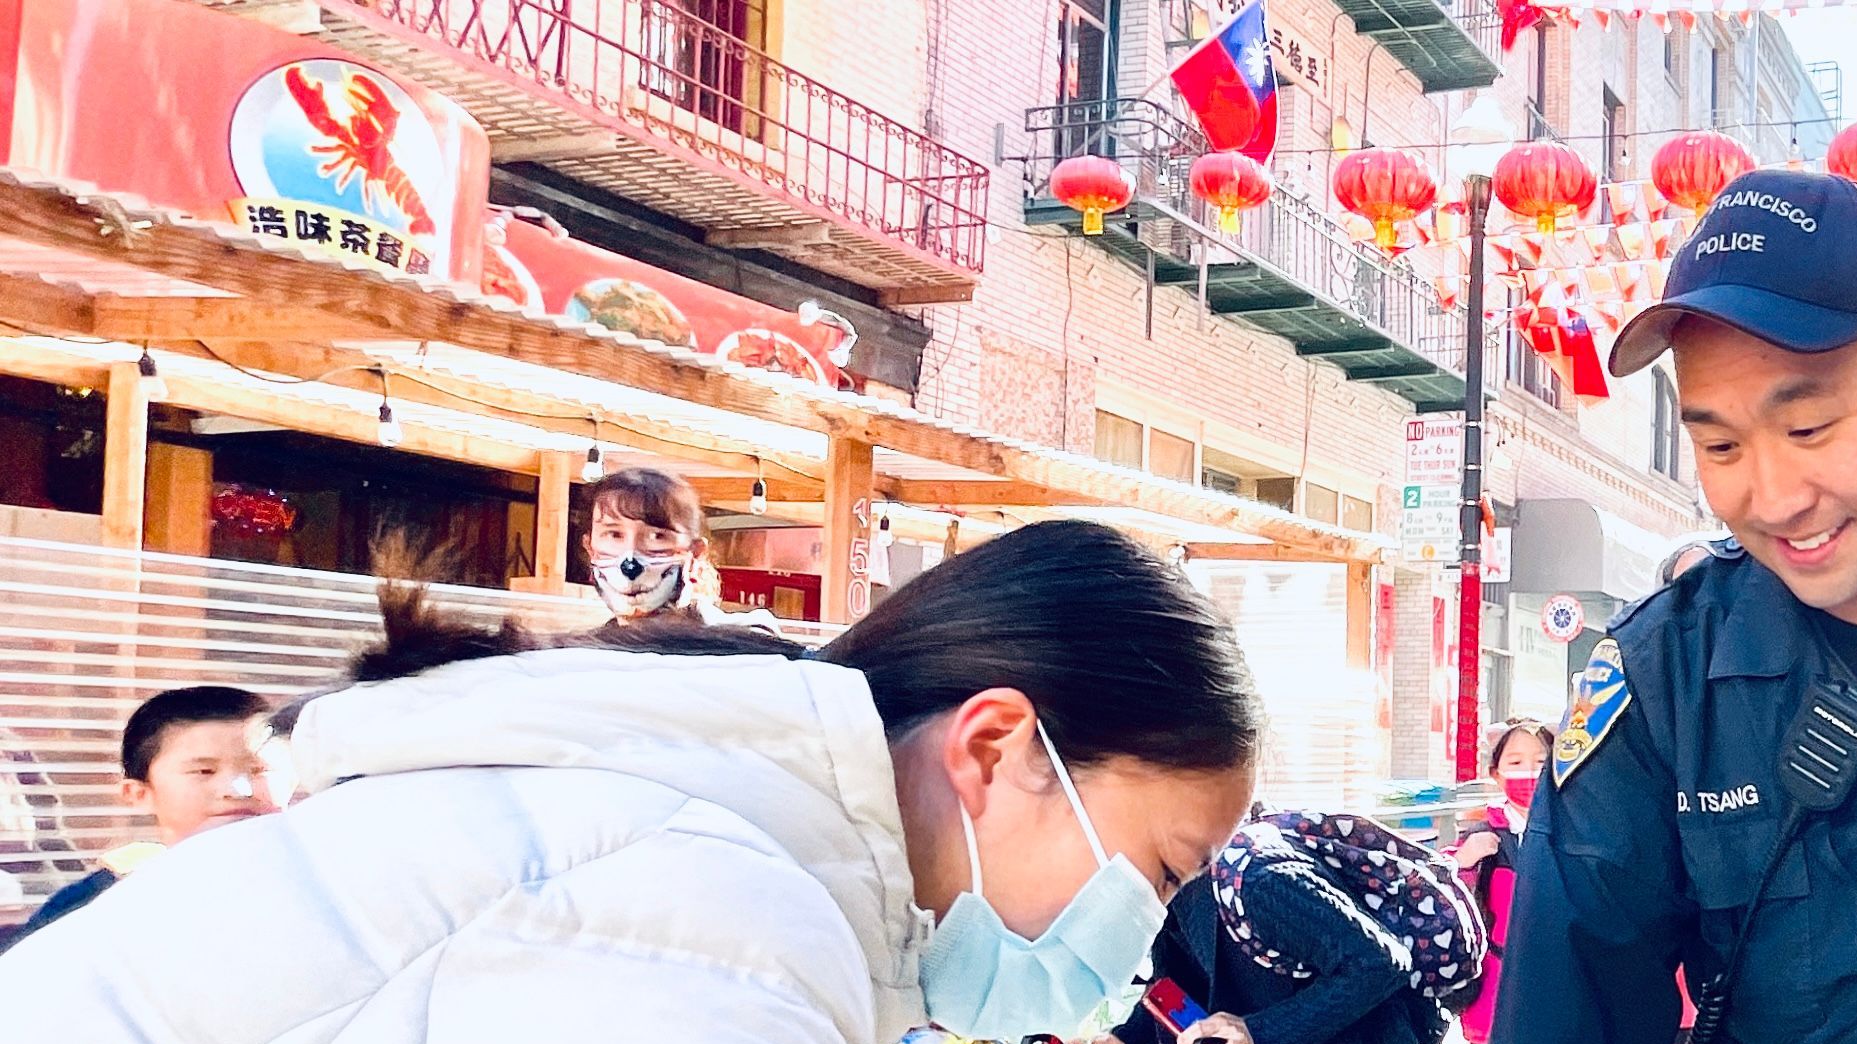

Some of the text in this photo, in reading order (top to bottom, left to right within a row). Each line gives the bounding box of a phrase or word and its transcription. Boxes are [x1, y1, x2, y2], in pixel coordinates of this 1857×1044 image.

[1695, 232, 1766, 261] POLICE
[1407, 422, 1460, 440] NO PARKING
[1407, 490, 1418, 507] 2
[1677, 784, 1760, 813] D. TSANG
